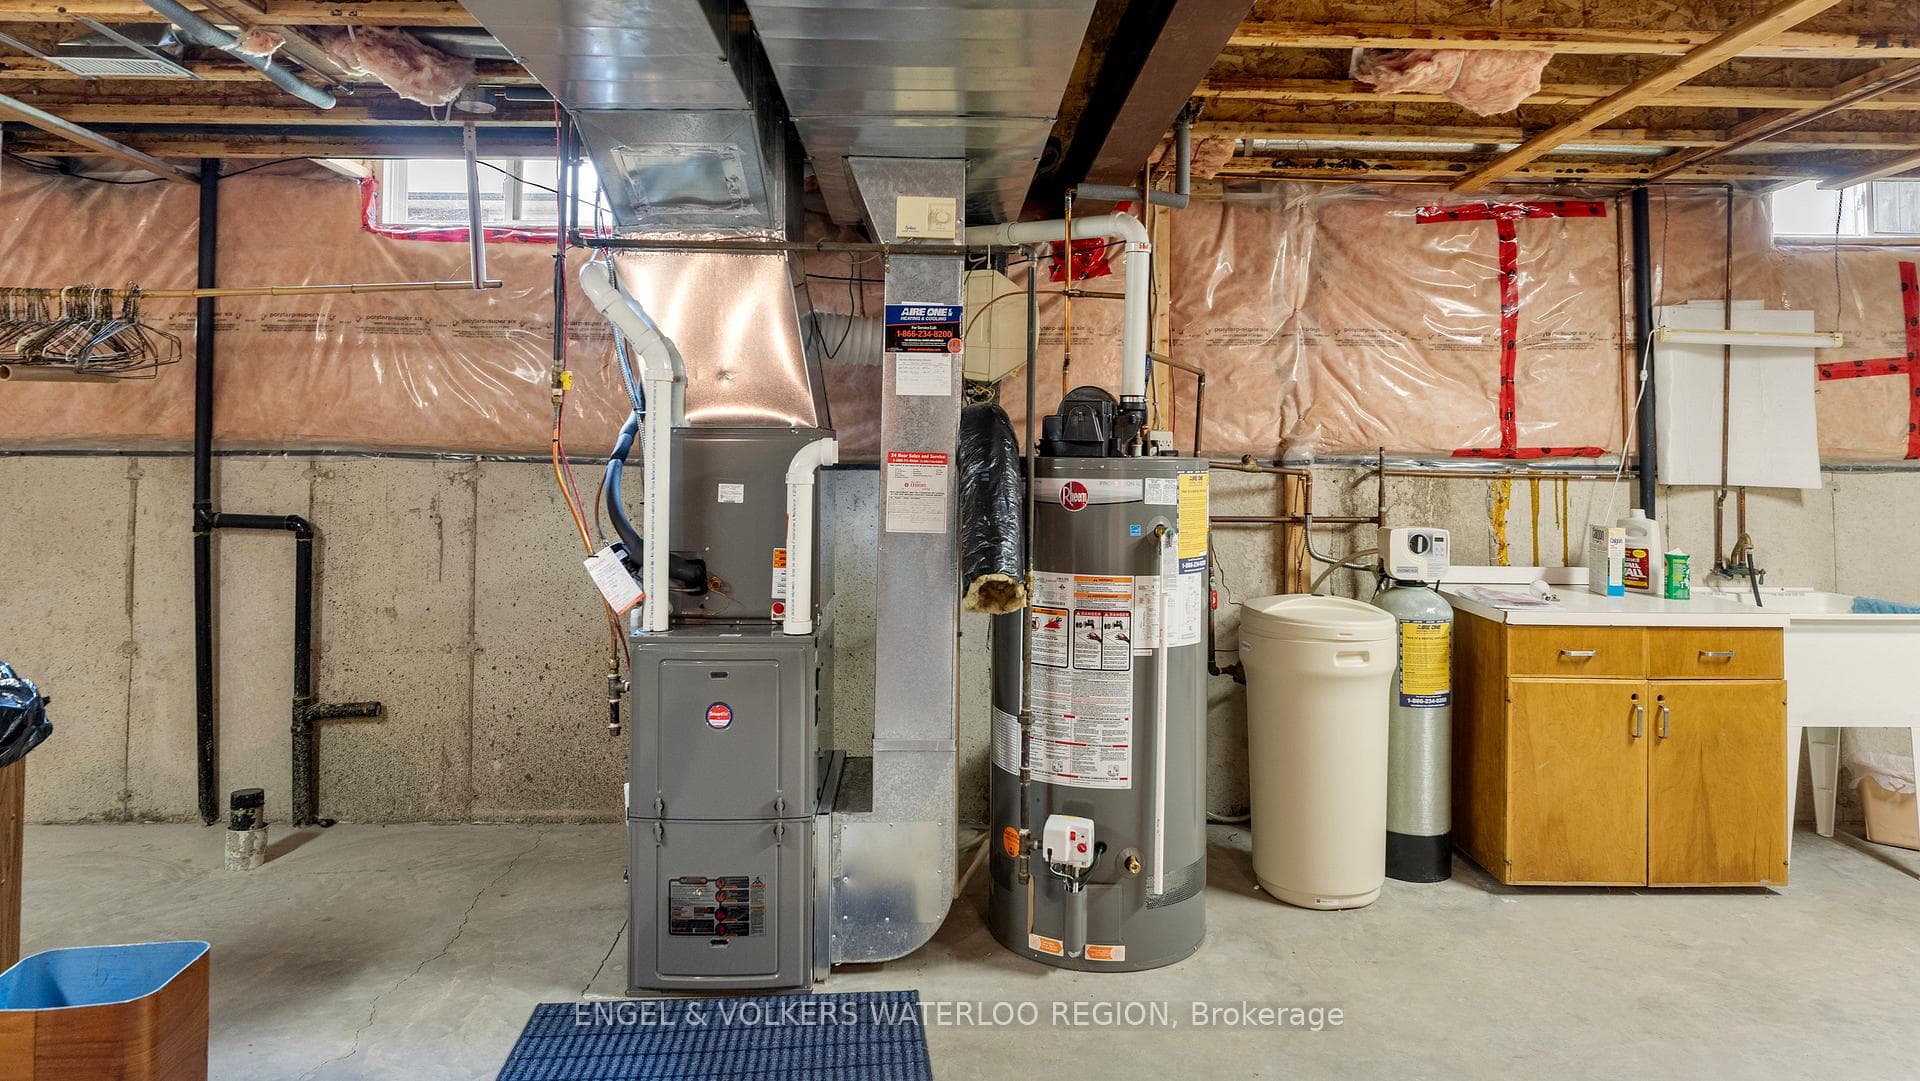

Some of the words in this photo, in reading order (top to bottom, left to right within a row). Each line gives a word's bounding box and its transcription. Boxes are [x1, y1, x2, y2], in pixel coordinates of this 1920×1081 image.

[901, 308, 926, 316] AIRE
[927, 308, 948, 316] ONE
[1062, 482, 1087, 506] Rheem
